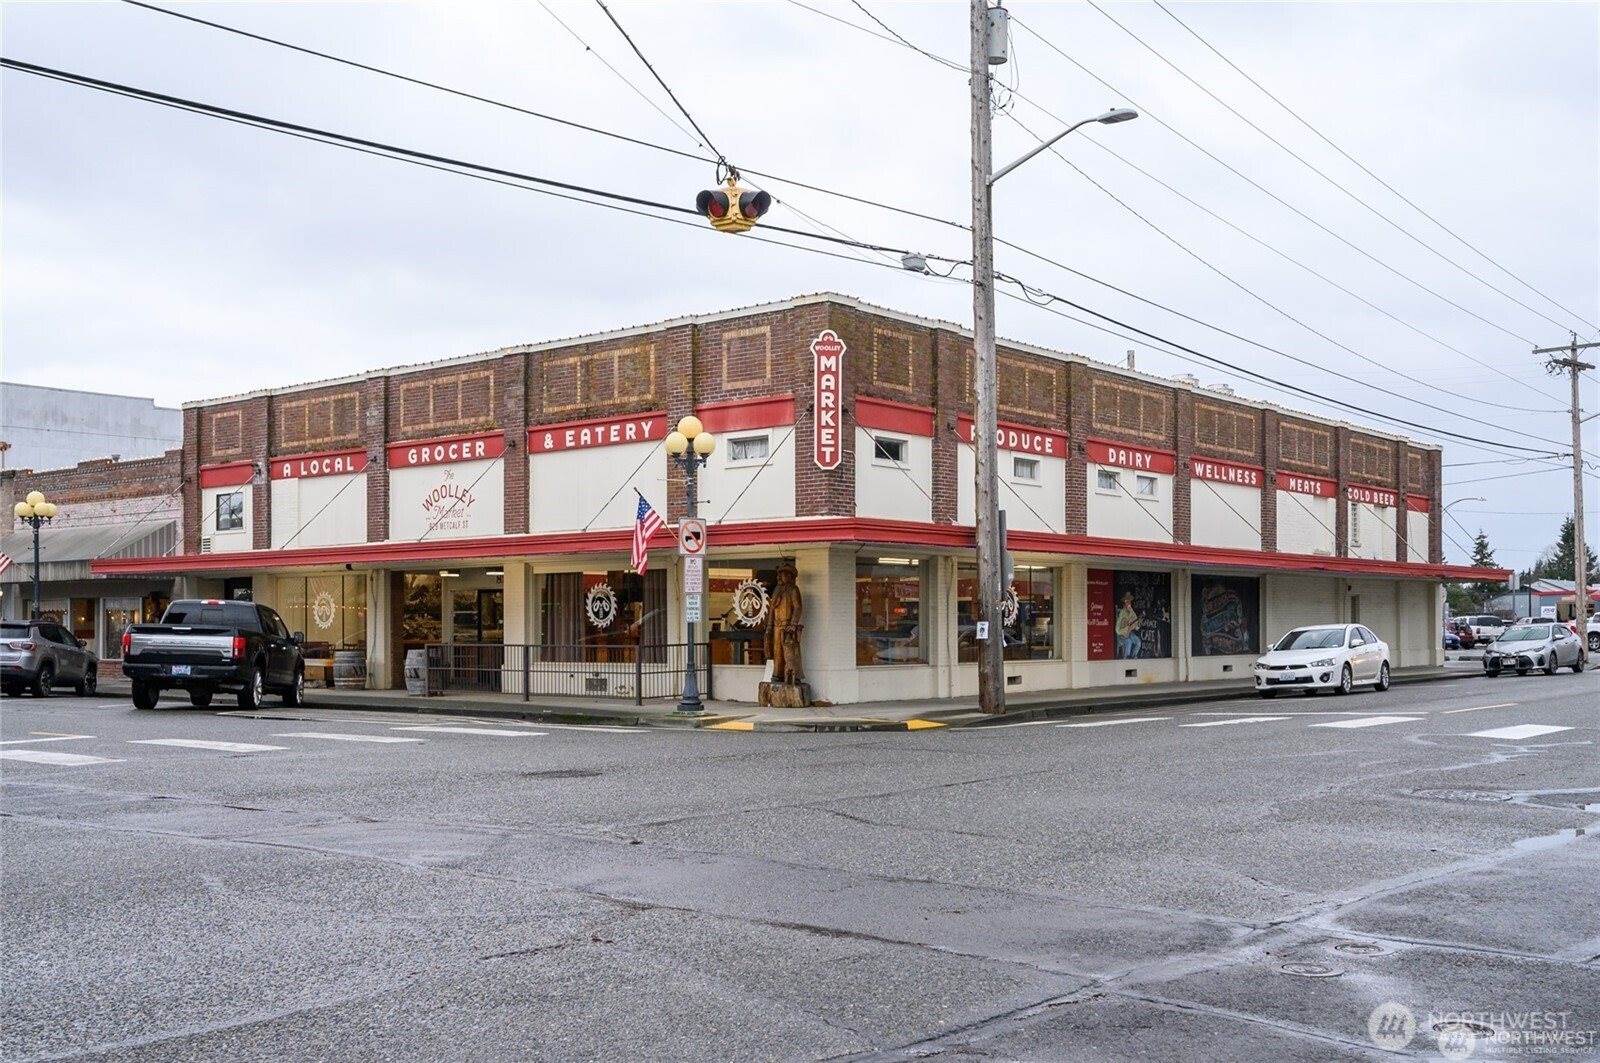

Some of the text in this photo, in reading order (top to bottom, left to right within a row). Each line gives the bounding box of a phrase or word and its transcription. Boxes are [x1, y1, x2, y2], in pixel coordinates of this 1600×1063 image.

[820, 355, 837, 463] MARKET
[544, 420, 653, 449] & EATERY
[408, 441, 485, 464] GROCER
[1108, 448, 1152, 468] DAIRY
[283, 456, 354, 477] A LOCAL
[1194, 462, 1257, 485] WELLNESS
[1289, 477, 1321, 494] MEATS
[1347, 487, 1395, 506] COLD BEER
[422, 484, 476, 511] WOOLLEY
